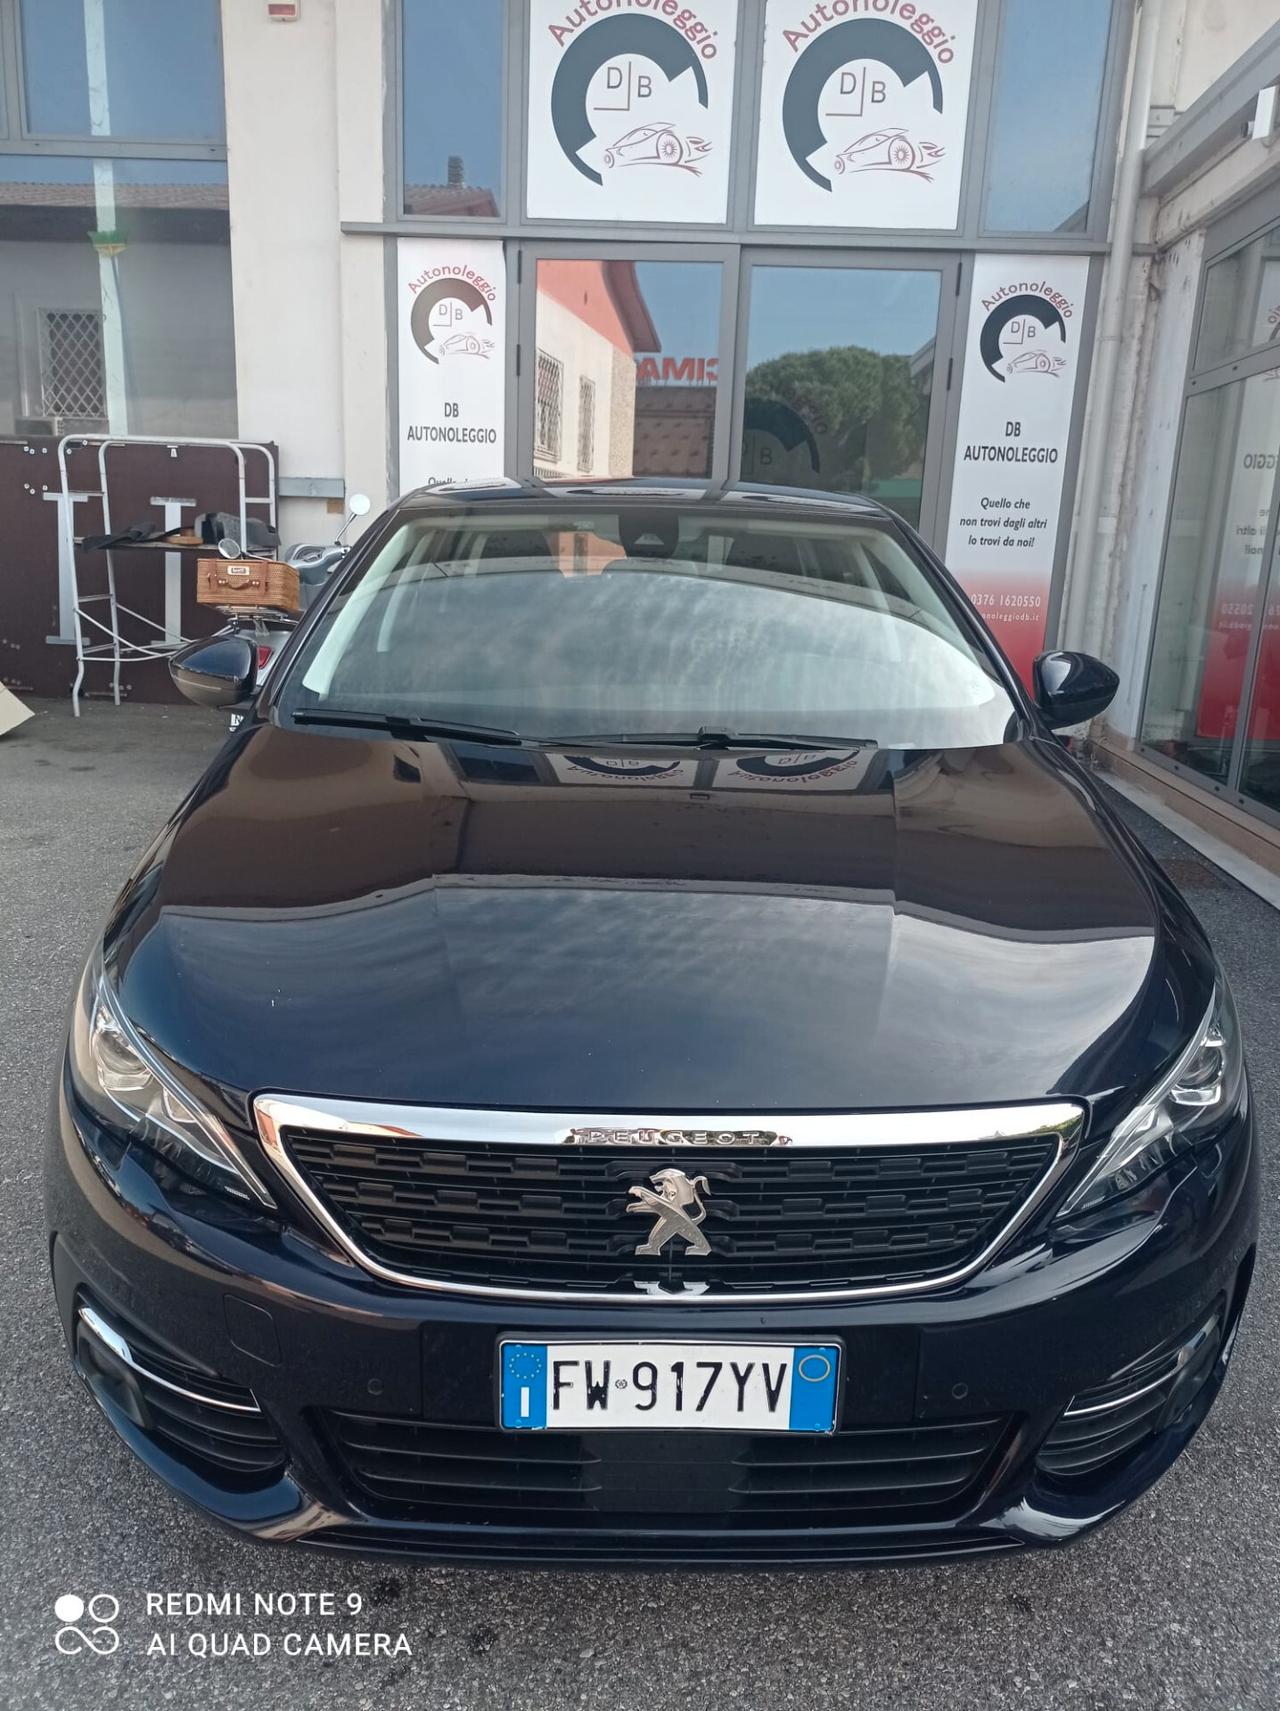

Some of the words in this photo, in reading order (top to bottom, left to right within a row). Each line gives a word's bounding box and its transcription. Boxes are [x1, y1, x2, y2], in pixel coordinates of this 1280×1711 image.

[606, 67, 623, 89] D
[637, 75, 652, 98] B
[840, 72, 857, 95] D
[870, 81, 886, 104] B
[407, 264, 497, 302] Autonoleggio
[981, 281, 1073, 319] Autonoleggio
[444, 402, 459, 418] DB
[407, 426, 497, 444] AUTONOLEGGIO
[1005, 421, 1021, 437] DB
[963, 445, 1059, 464] AUTONOLEGGIO
[980, 497, 1012, 510] Quello
[1014, 498, 1031, 510] che
[959, 518, 978, 527] non
[980, 516, 1001, 527] trovi
[1003, 516, 1026, 531] dagli
[1028, 517, 1048, 529] altri
[968, 534, 977, 546] lo
[980, 535, 1001, 547] trovi
[1003, 536, 1015, 547] da
[1017, 536, 1036, 548] noi!
[971, 593, 995, 606] 0376
[1000, 594, 1041, 608] 1620550
[588, 1129, 760, 1145] PEUGEOT
